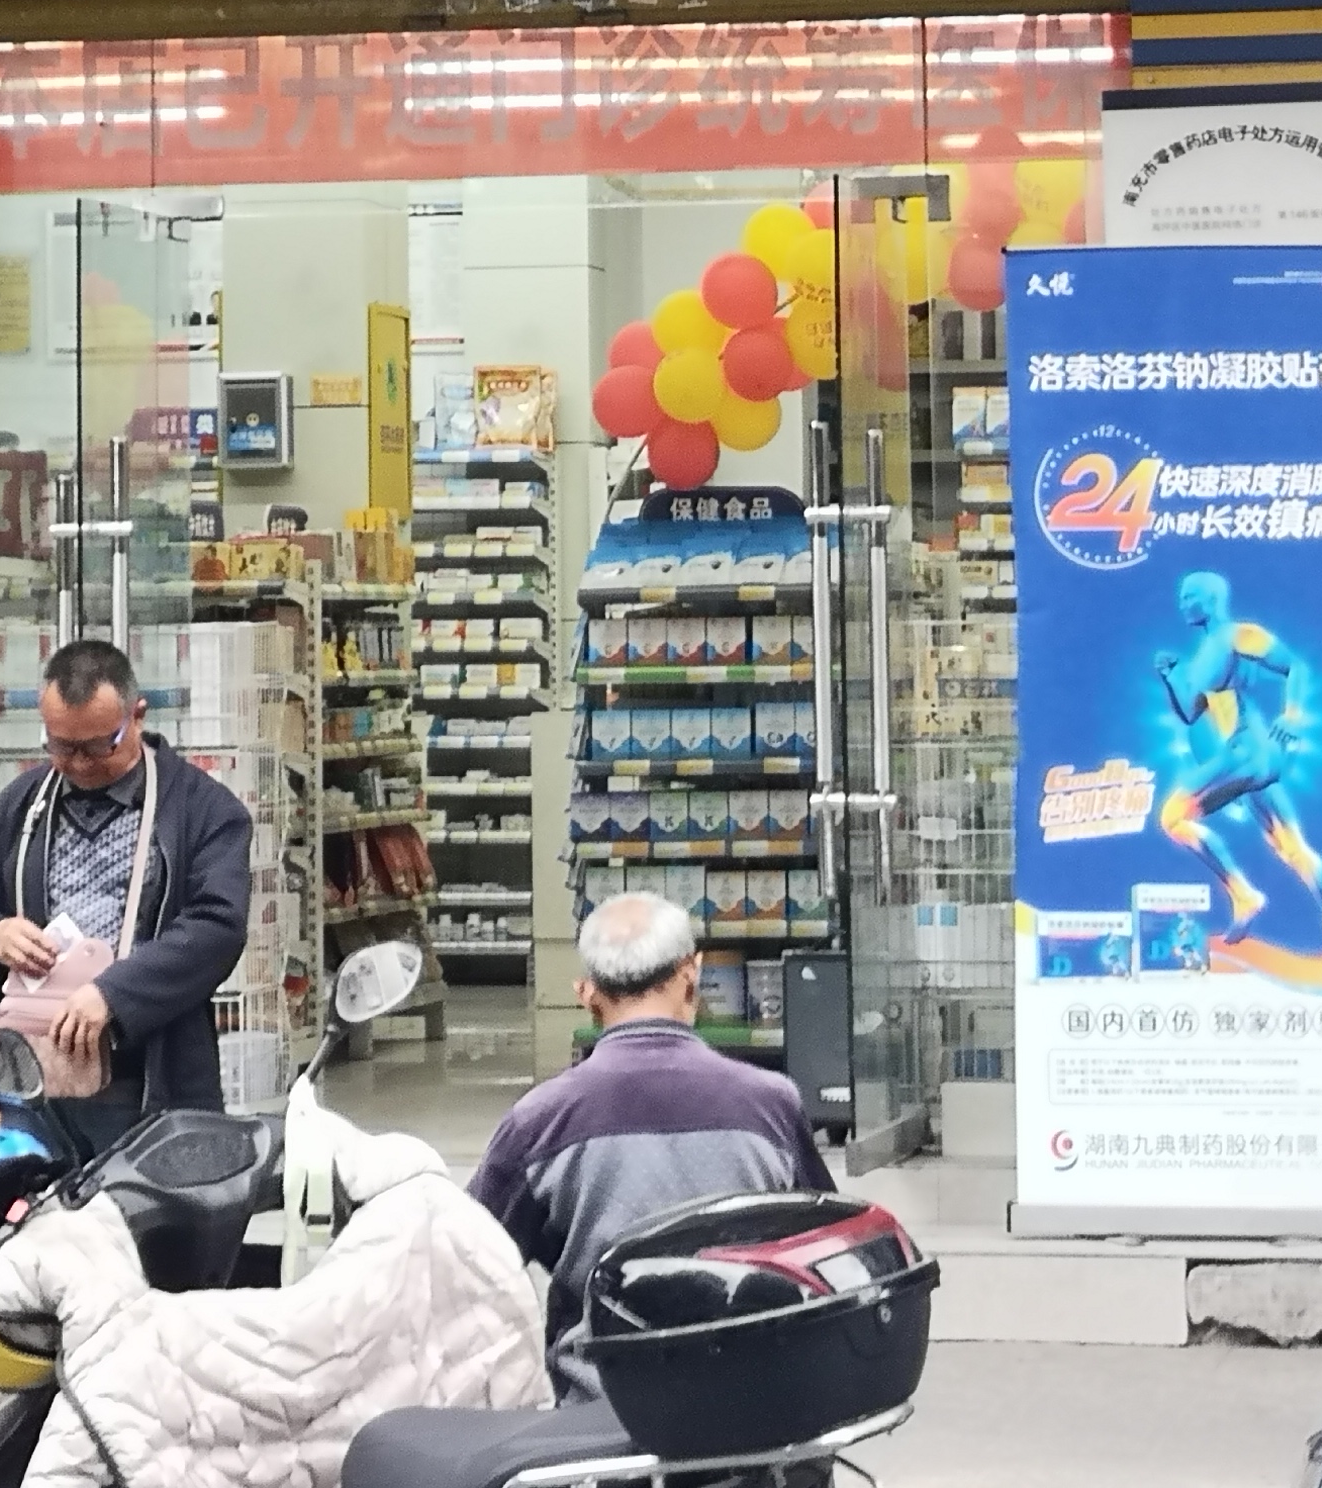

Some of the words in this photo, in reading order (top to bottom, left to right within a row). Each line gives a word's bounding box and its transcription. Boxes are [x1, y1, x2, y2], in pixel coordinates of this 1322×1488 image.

[669, 496, 773, 521] 保健食品
[1048, 453, 1164, 553] 24
[1065, 1008, 1197, 1036] 国内首仿
[1085, 1160, 1129, 1170] HUNAN
[1136, 1160, 1183, 1170] JIUDIAN
